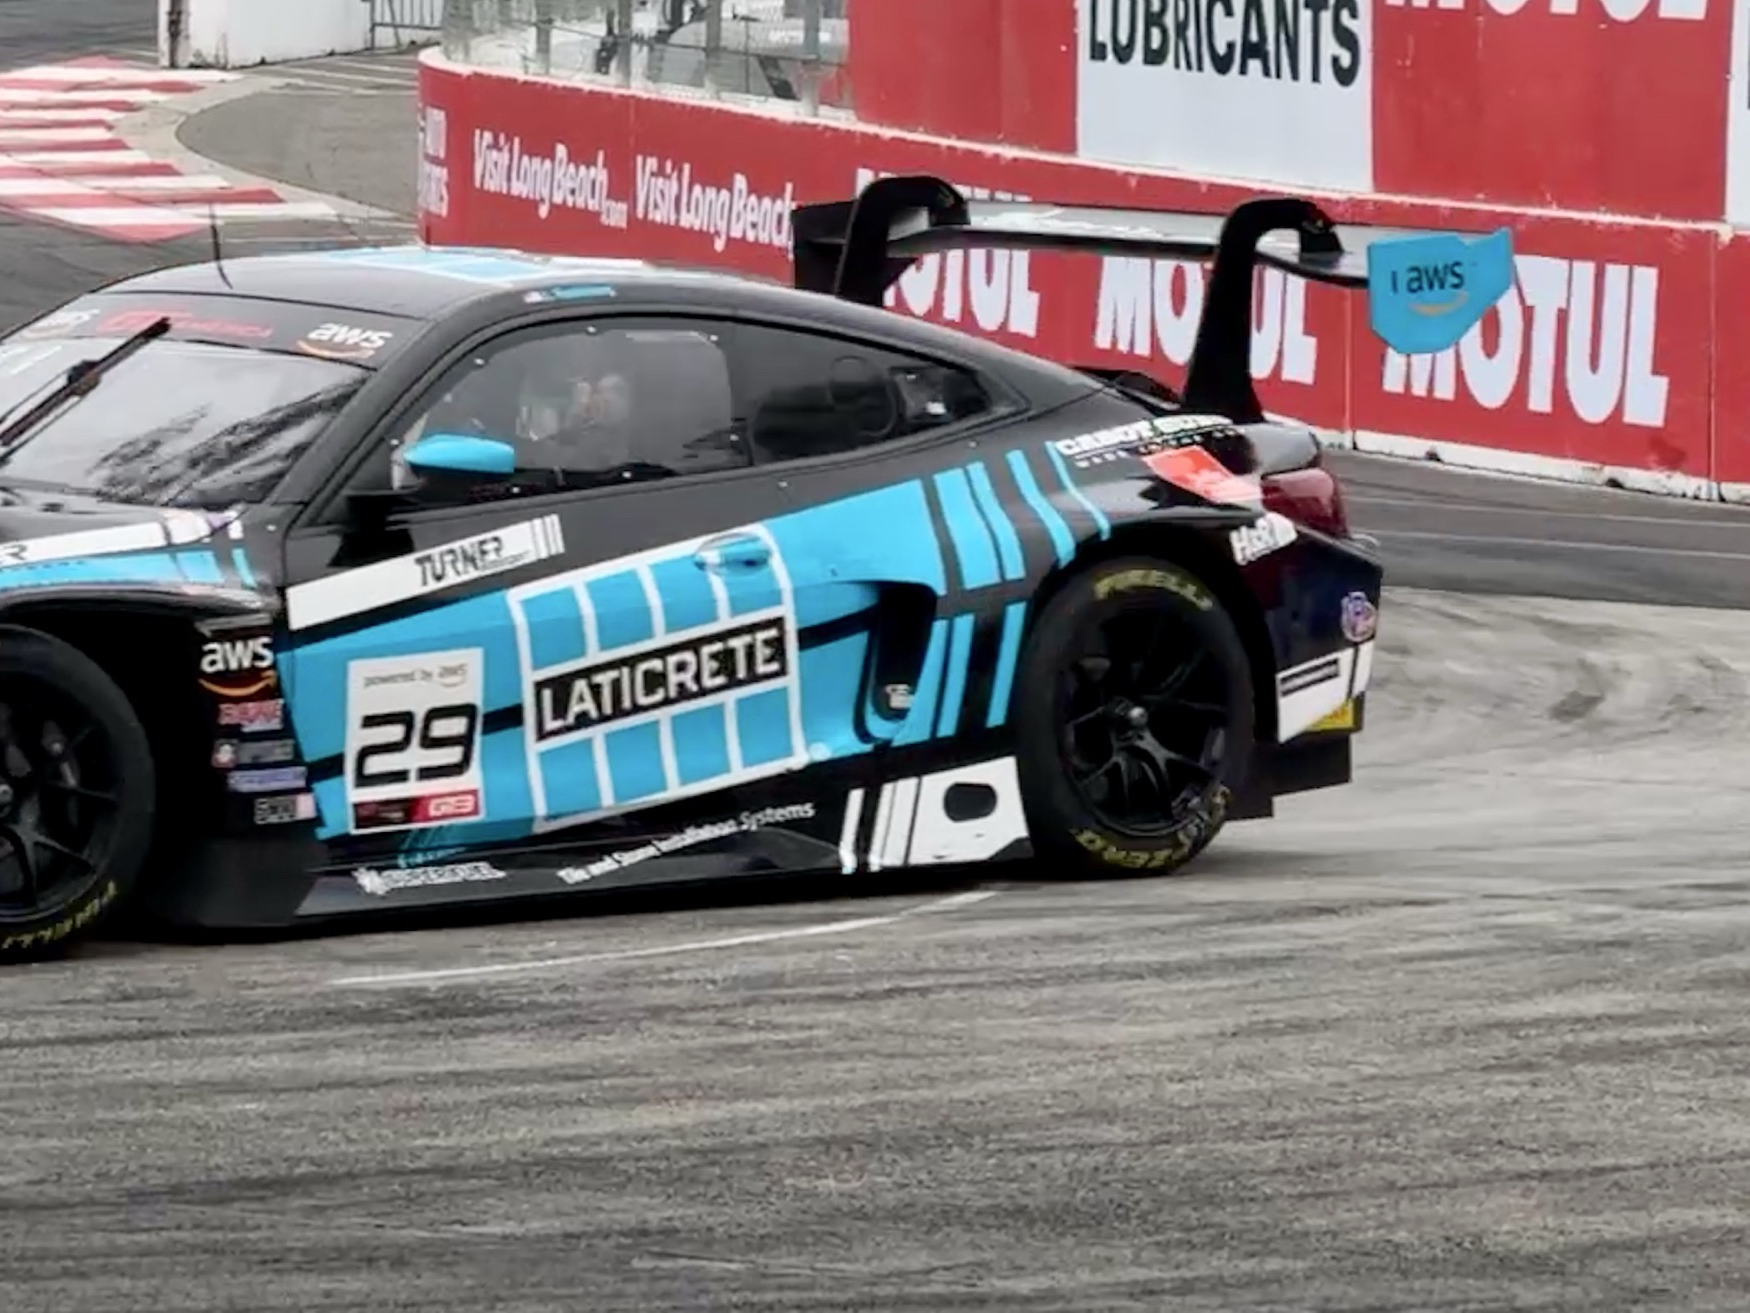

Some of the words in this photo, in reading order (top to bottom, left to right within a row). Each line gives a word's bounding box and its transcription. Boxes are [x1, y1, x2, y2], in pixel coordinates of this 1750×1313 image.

[474, 128, 510, 194] Visit
[510, 136, 552, 220] Long
[552, 142, 608, 212] Beach
[636, 154, 679, 226] Visit
[679, 163, 731, 253] Long
[1406, 261, 1465, 294] aws
[306, 322, 393, 349] aws
[1094, 256, 1318, 385] MOUL
[414, 535, 503, 587] TURNER
[201, 636, 275, 674] aws
[542, 629, 783, 733] LATICRETE
[354, 702, 478, 789] 29
[740, 802, 815, 831] Systems
